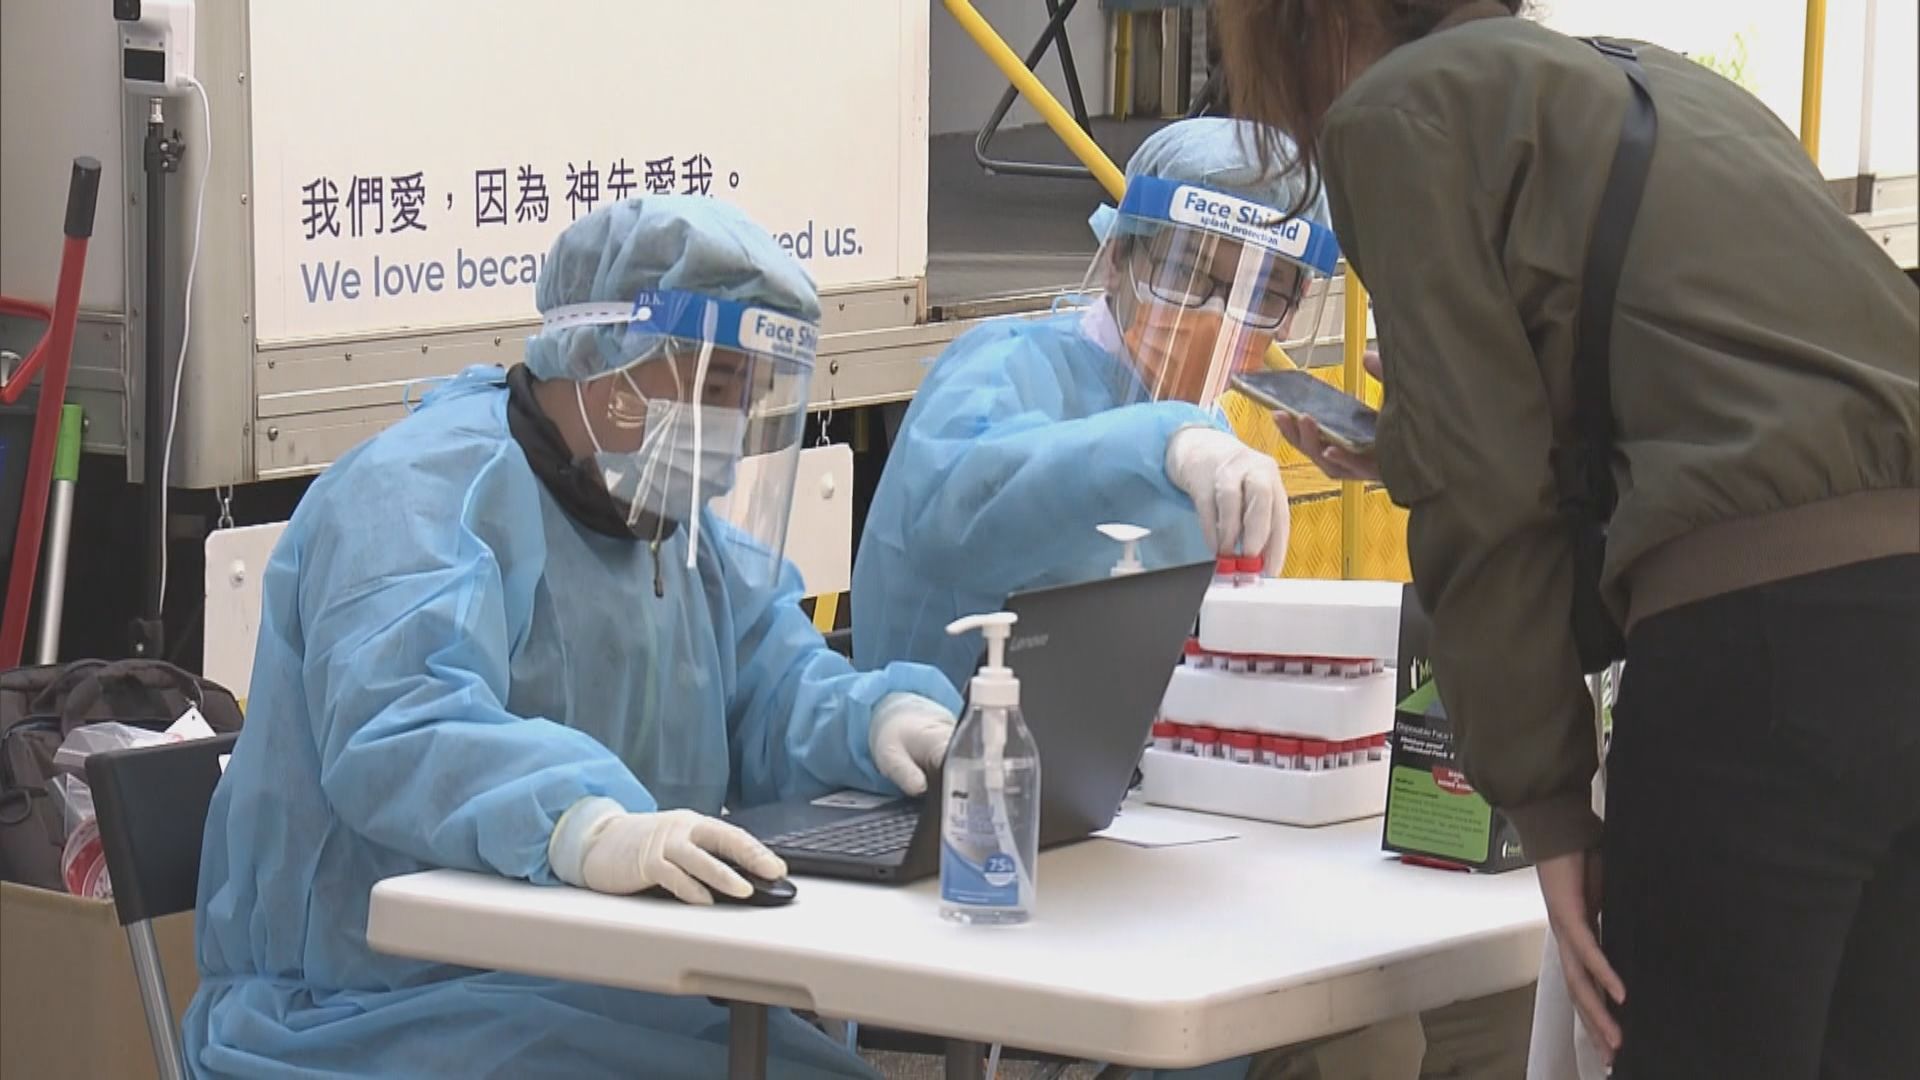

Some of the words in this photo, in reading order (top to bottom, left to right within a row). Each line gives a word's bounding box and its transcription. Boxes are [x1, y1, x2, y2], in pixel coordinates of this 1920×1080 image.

[1184, 191, 1230, 217] Face
[1201, 216, 1230, 231] splash
[300, 260, 361, 303] We
[374, 255, 445, 297] love
[457, 248, 546, 290] beca
[772, 220, 813, 259] ed
[824, 227, 863, 257] us.
[755, 314, 794, 343] Face
